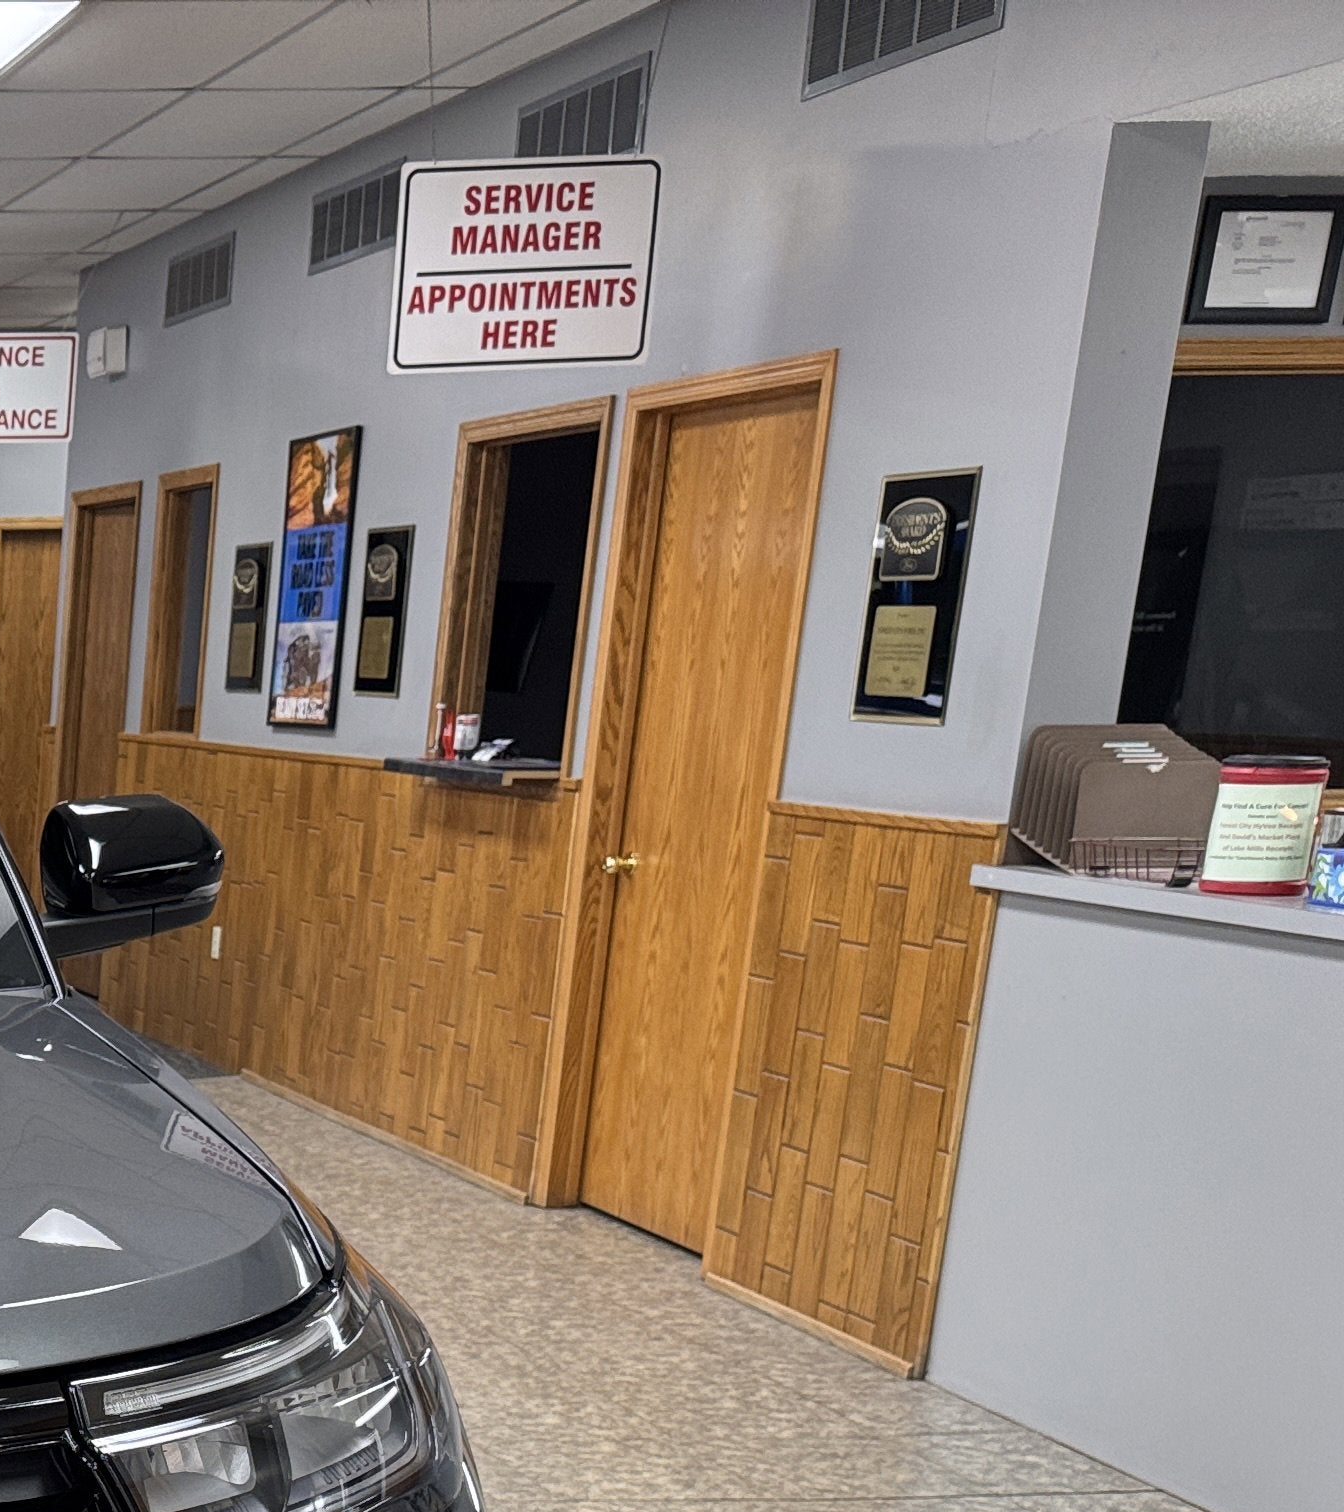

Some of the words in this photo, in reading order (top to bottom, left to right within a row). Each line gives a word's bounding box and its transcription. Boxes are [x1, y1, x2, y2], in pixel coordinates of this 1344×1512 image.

[463, 181, 596, 216] SERVICE
[450, 220, 602, 255] MANAGER
[407, 277, 638, 315] APPOINTMENTS
[480, 318, 558, 350] HERE
